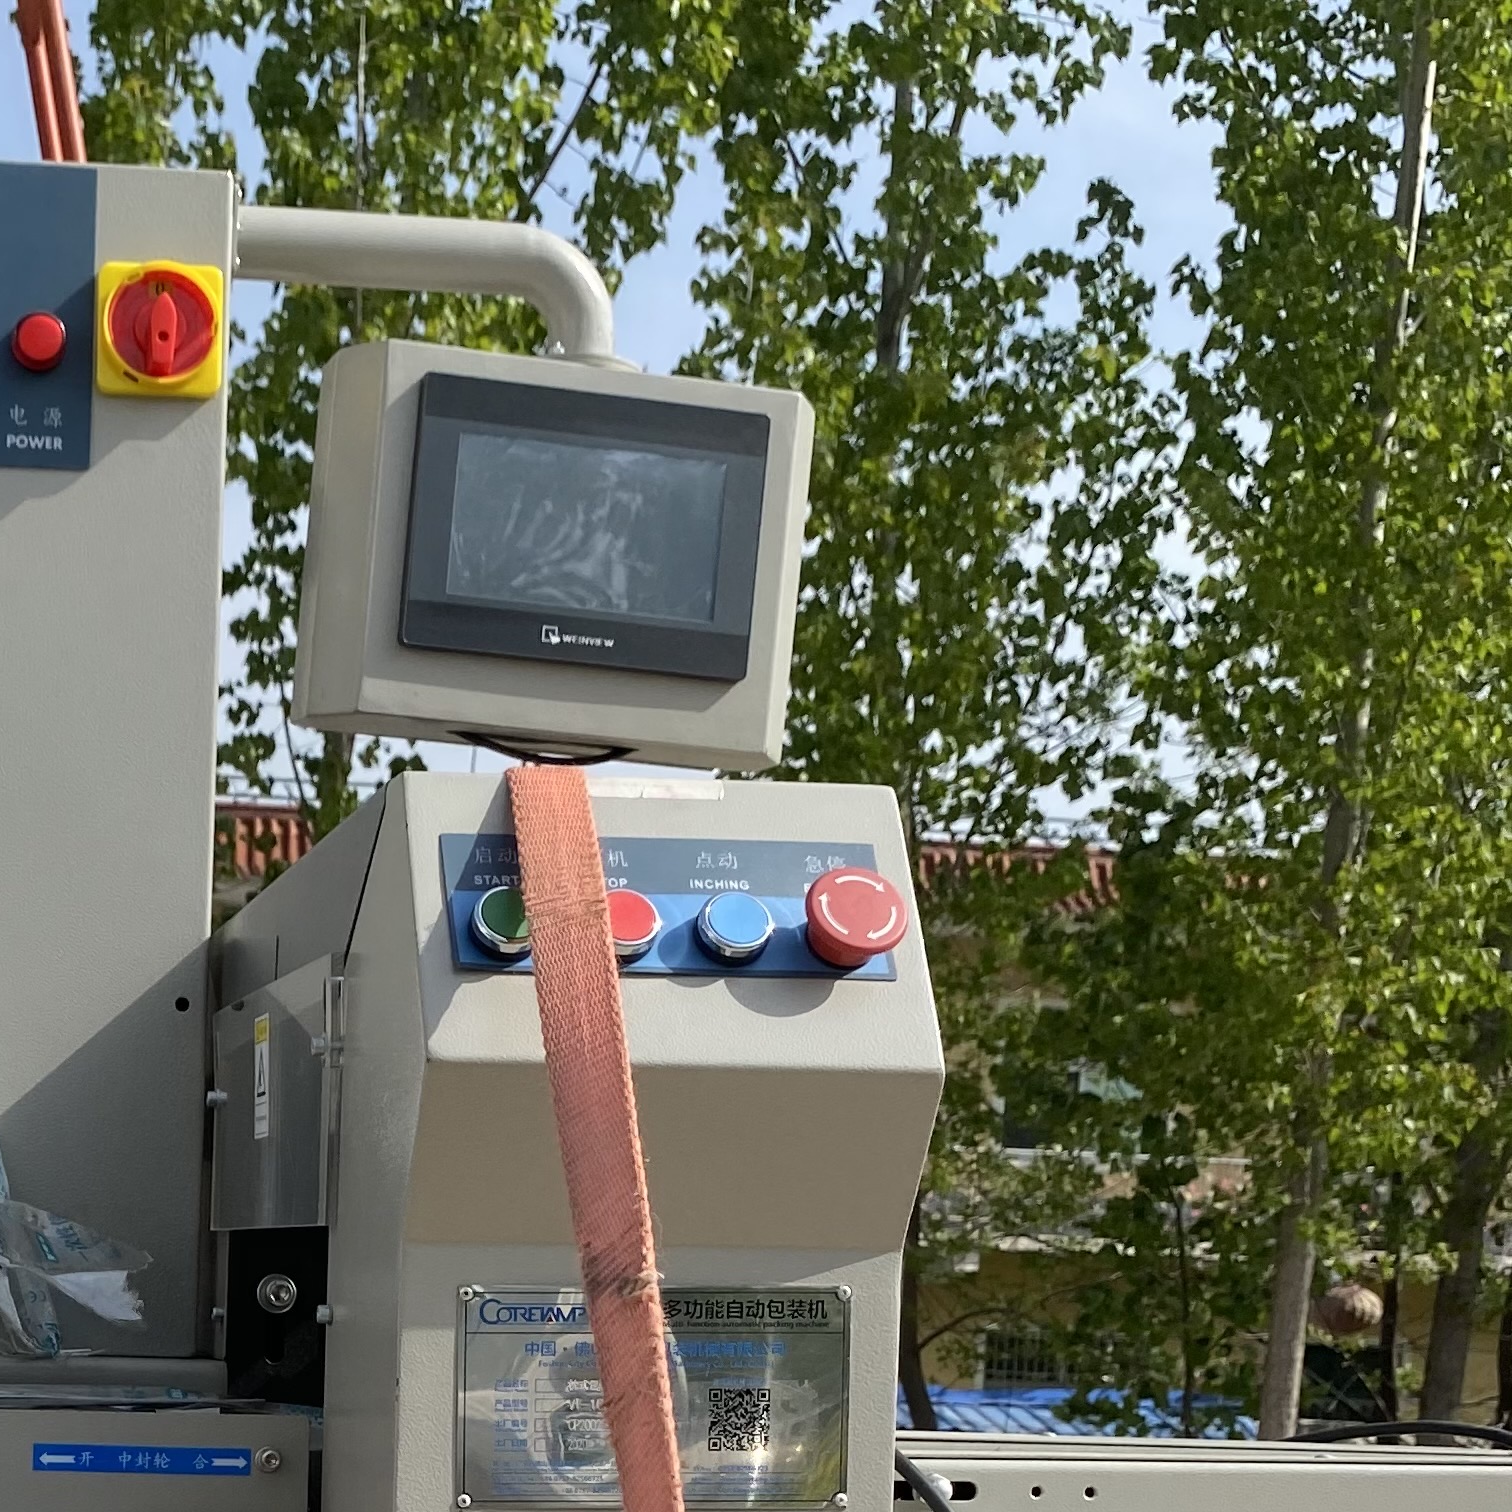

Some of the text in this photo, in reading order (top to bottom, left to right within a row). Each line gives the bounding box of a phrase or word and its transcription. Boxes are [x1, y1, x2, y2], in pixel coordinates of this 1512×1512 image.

[10, 404, 63, 428] 电源
[6, 434, 63, 451] POWER
[562, 633, 615, 648] WEINVIEW
[607, 850, 629, 868] 机
[696, 851, 738, 870] 点动
[474, 875, 520, 886] START
[689, 878, 749, 891] INCHING
[663, 1299, 828, 1320] 多功能自动包装机
[78, 1450, 209, 1470] 开 中封轮 合
